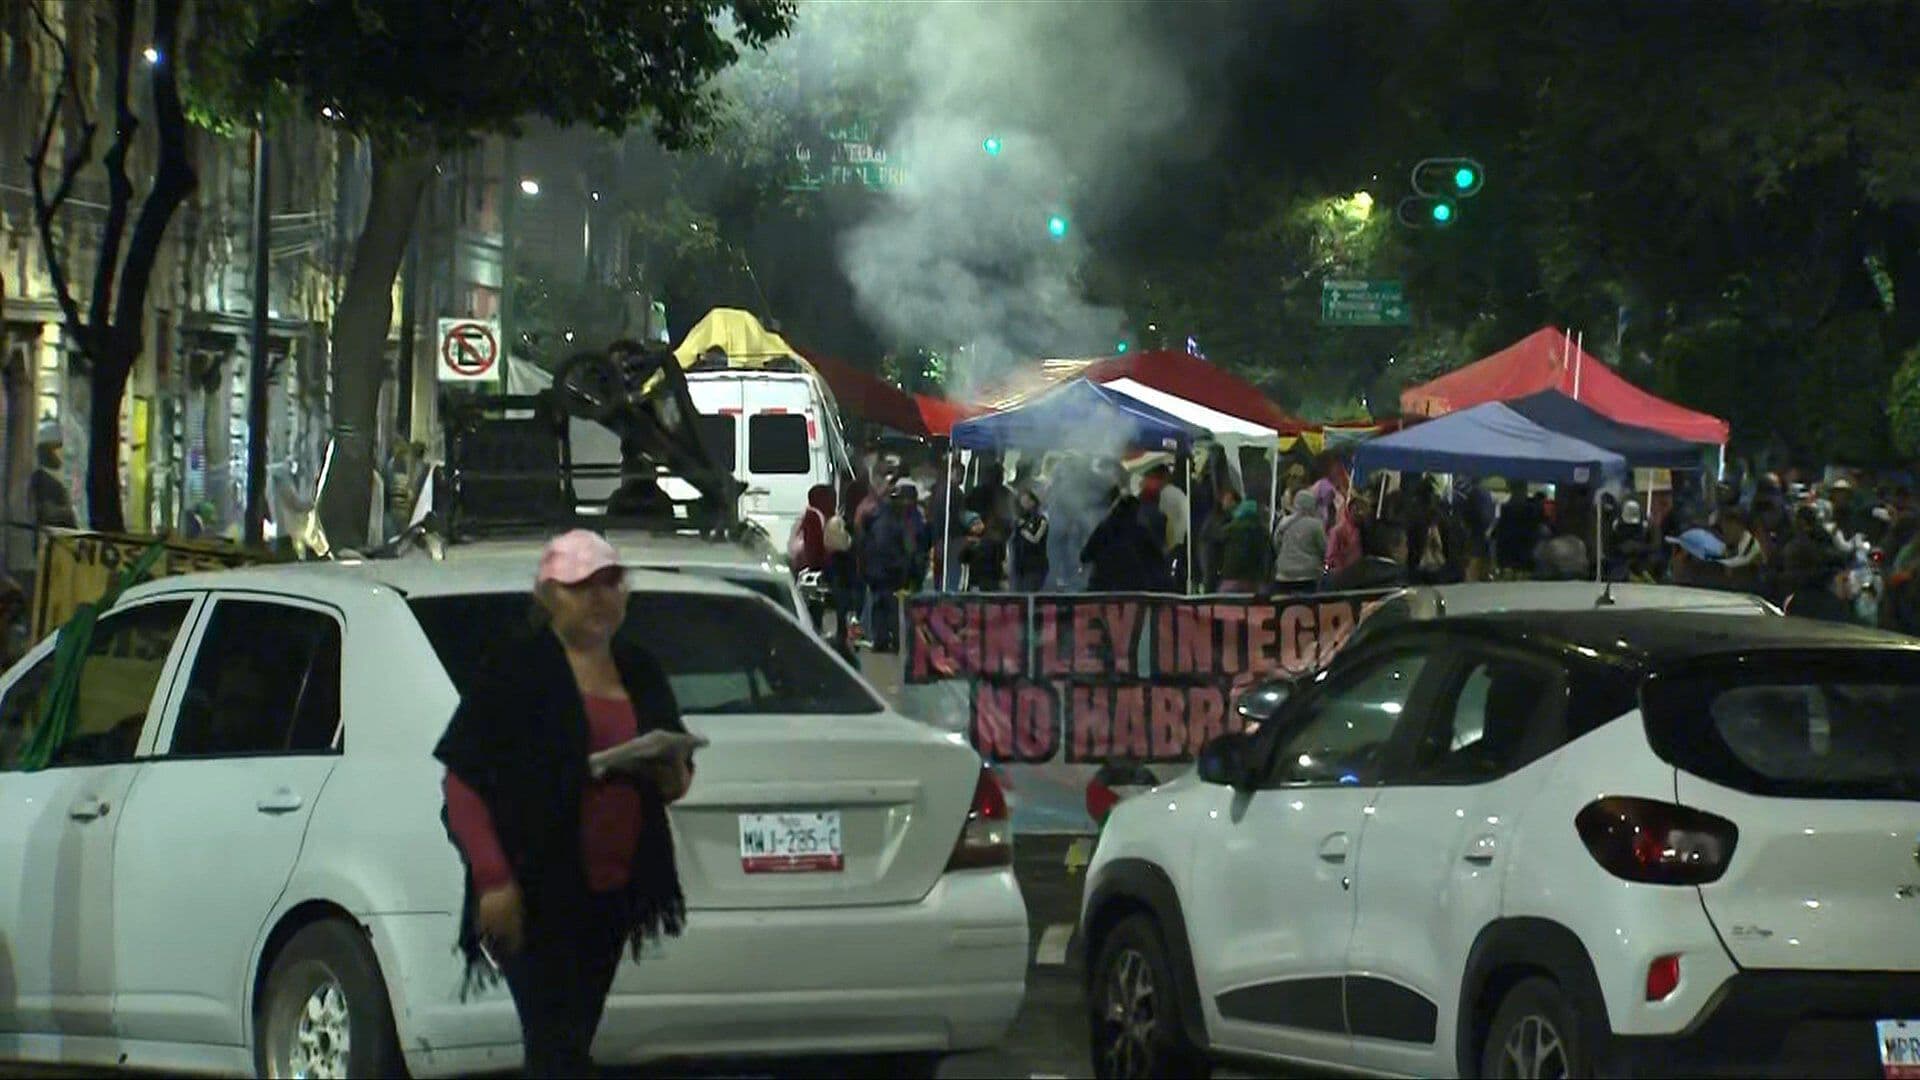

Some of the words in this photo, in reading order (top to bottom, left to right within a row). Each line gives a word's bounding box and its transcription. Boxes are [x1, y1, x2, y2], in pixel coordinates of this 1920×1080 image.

[1039, 602, 1139, 675] LEY
[1157, 600, 1372, 675] INTEGR
[972, 681, 1053, 757] NO
